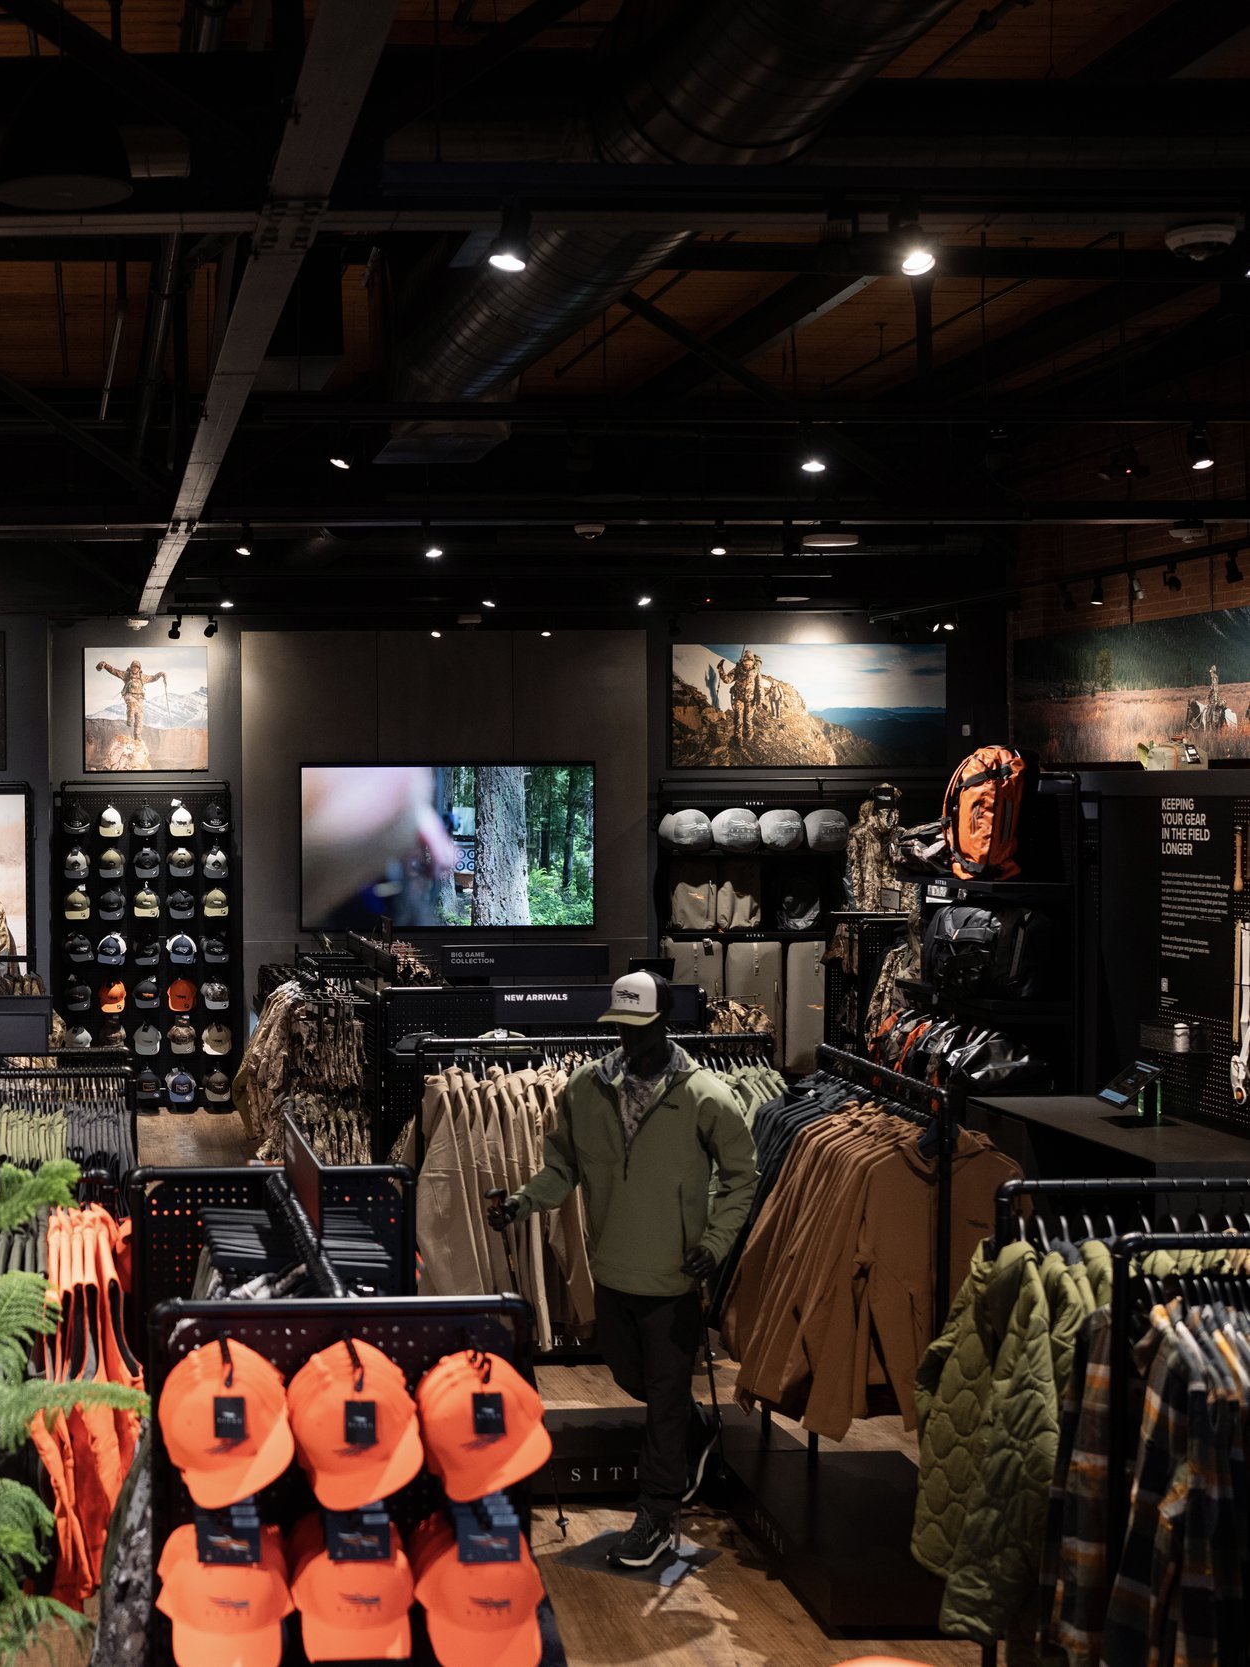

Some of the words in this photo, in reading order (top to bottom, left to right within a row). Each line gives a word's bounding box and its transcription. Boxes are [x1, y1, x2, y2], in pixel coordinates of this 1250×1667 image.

[1161, 798, 1194, 810] KEEPING
[1161, 812, 1183, 825] YOUR
[1185, 813, 1207, 826] GEAR
[1161, 828, 1170, 839] IN
[1171, 828, 1186, 840] THE
[1188, 828, 1210, 841] FIELD
[1161, 842, 1193, 856] LONGER
